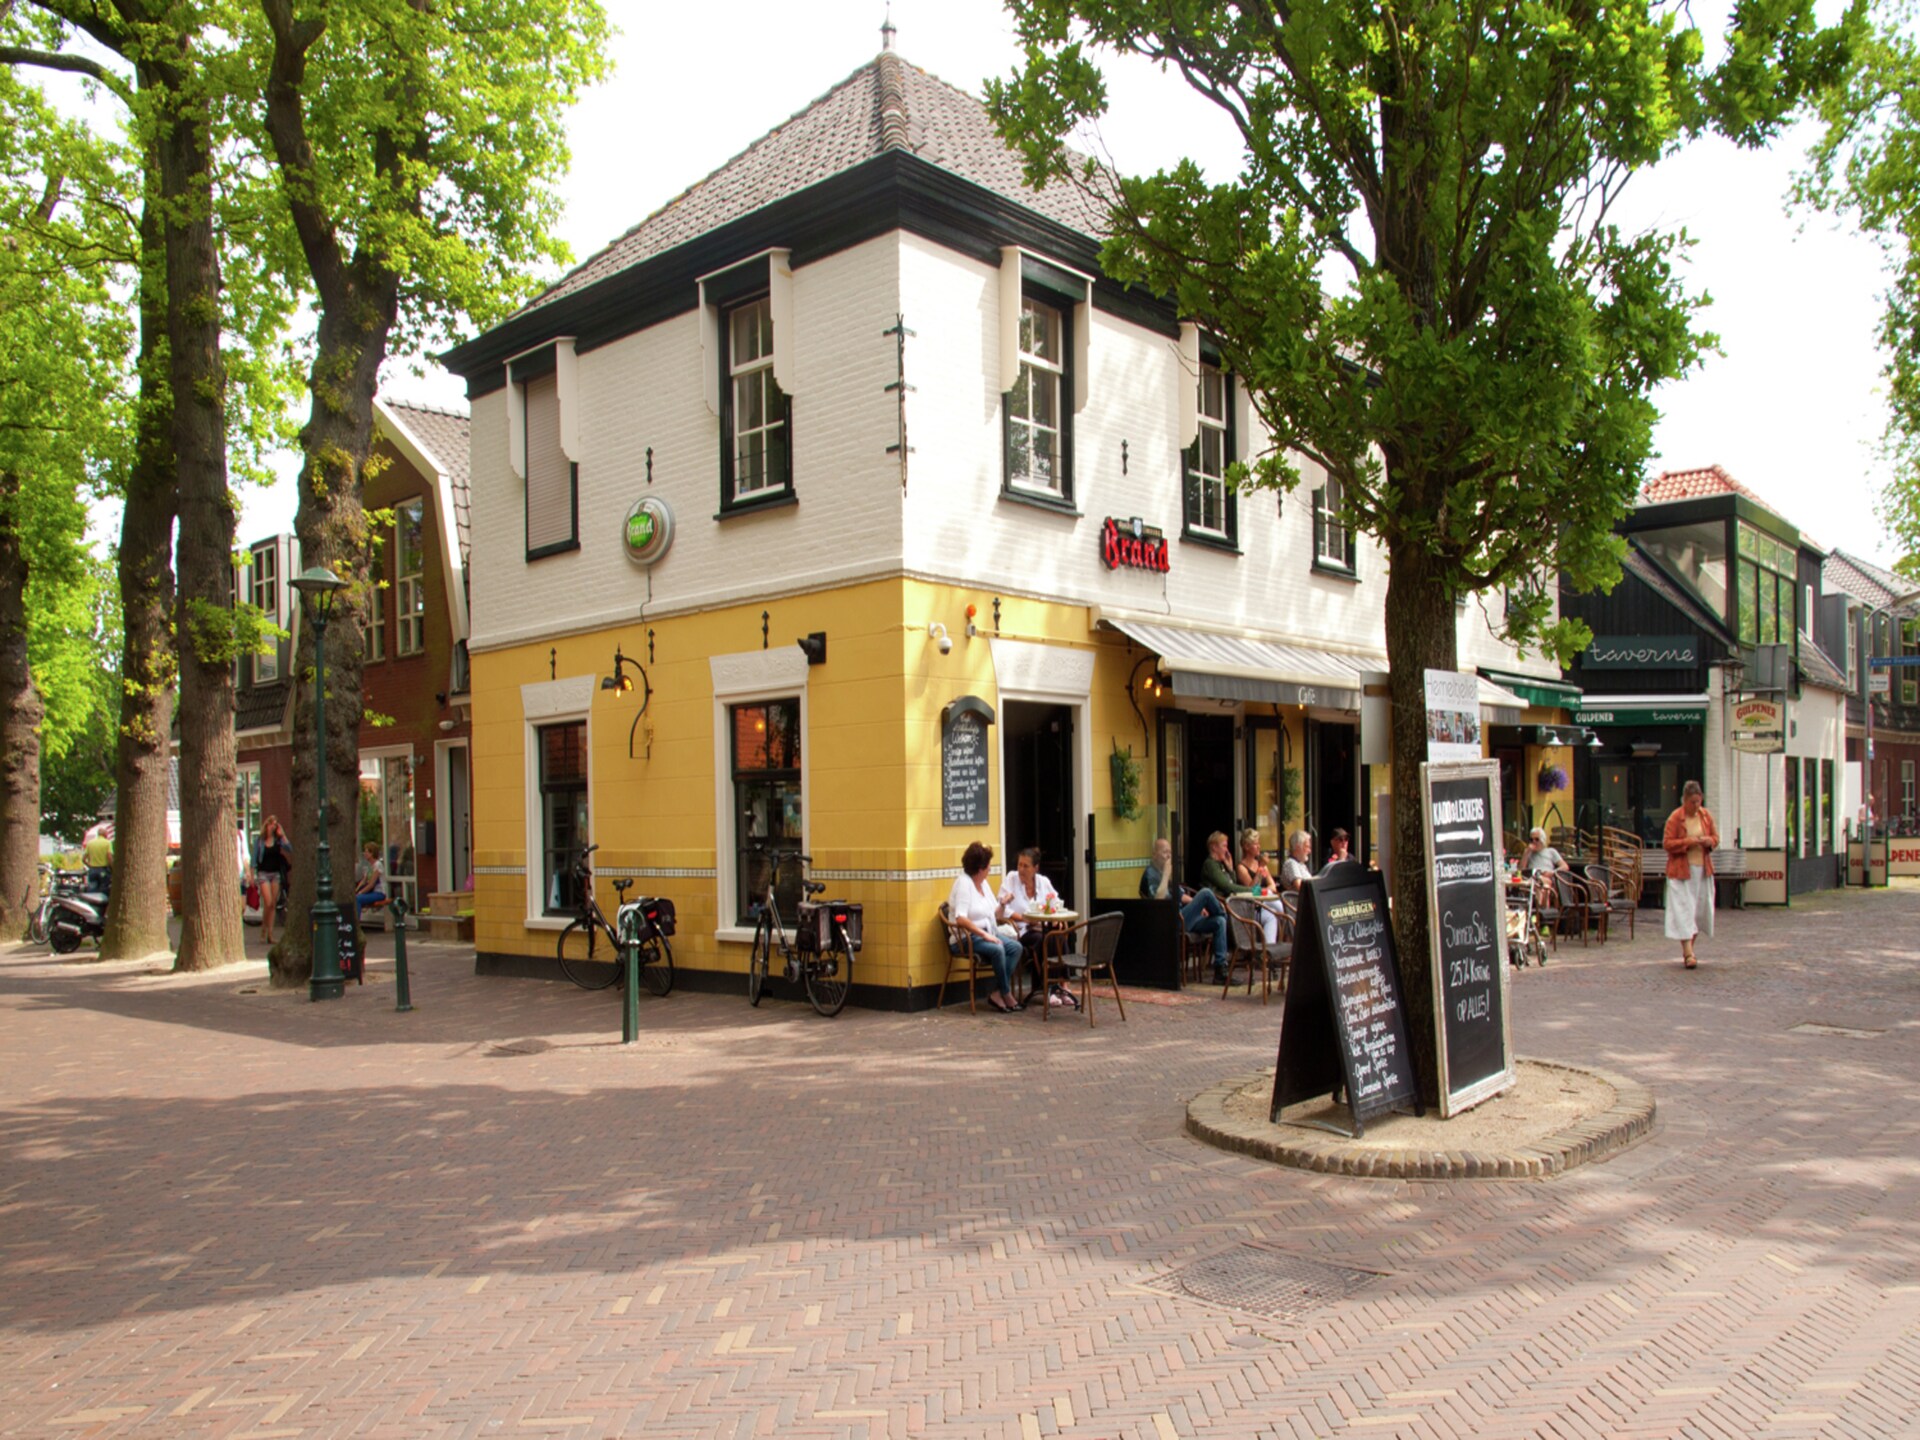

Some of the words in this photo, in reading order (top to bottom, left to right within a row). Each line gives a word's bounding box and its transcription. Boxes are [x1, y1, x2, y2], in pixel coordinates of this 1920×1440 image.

[1104, 515, 1169, 573] Brand
[1590, 642, 1694, 662] taverne
[1575, 712, 1614, 723] GULPENER
[1652, 710, 1702, 721] taverne
[1736, 703, 1776, 719] GULPENER
[1330, 902, 1374, 918] GRIMBERGEN
[1450, 957, 1469, 987] 25%
[1456, 999, 1467, 1023] OP
[1467, 988, 1490, 1022] ALLES!
